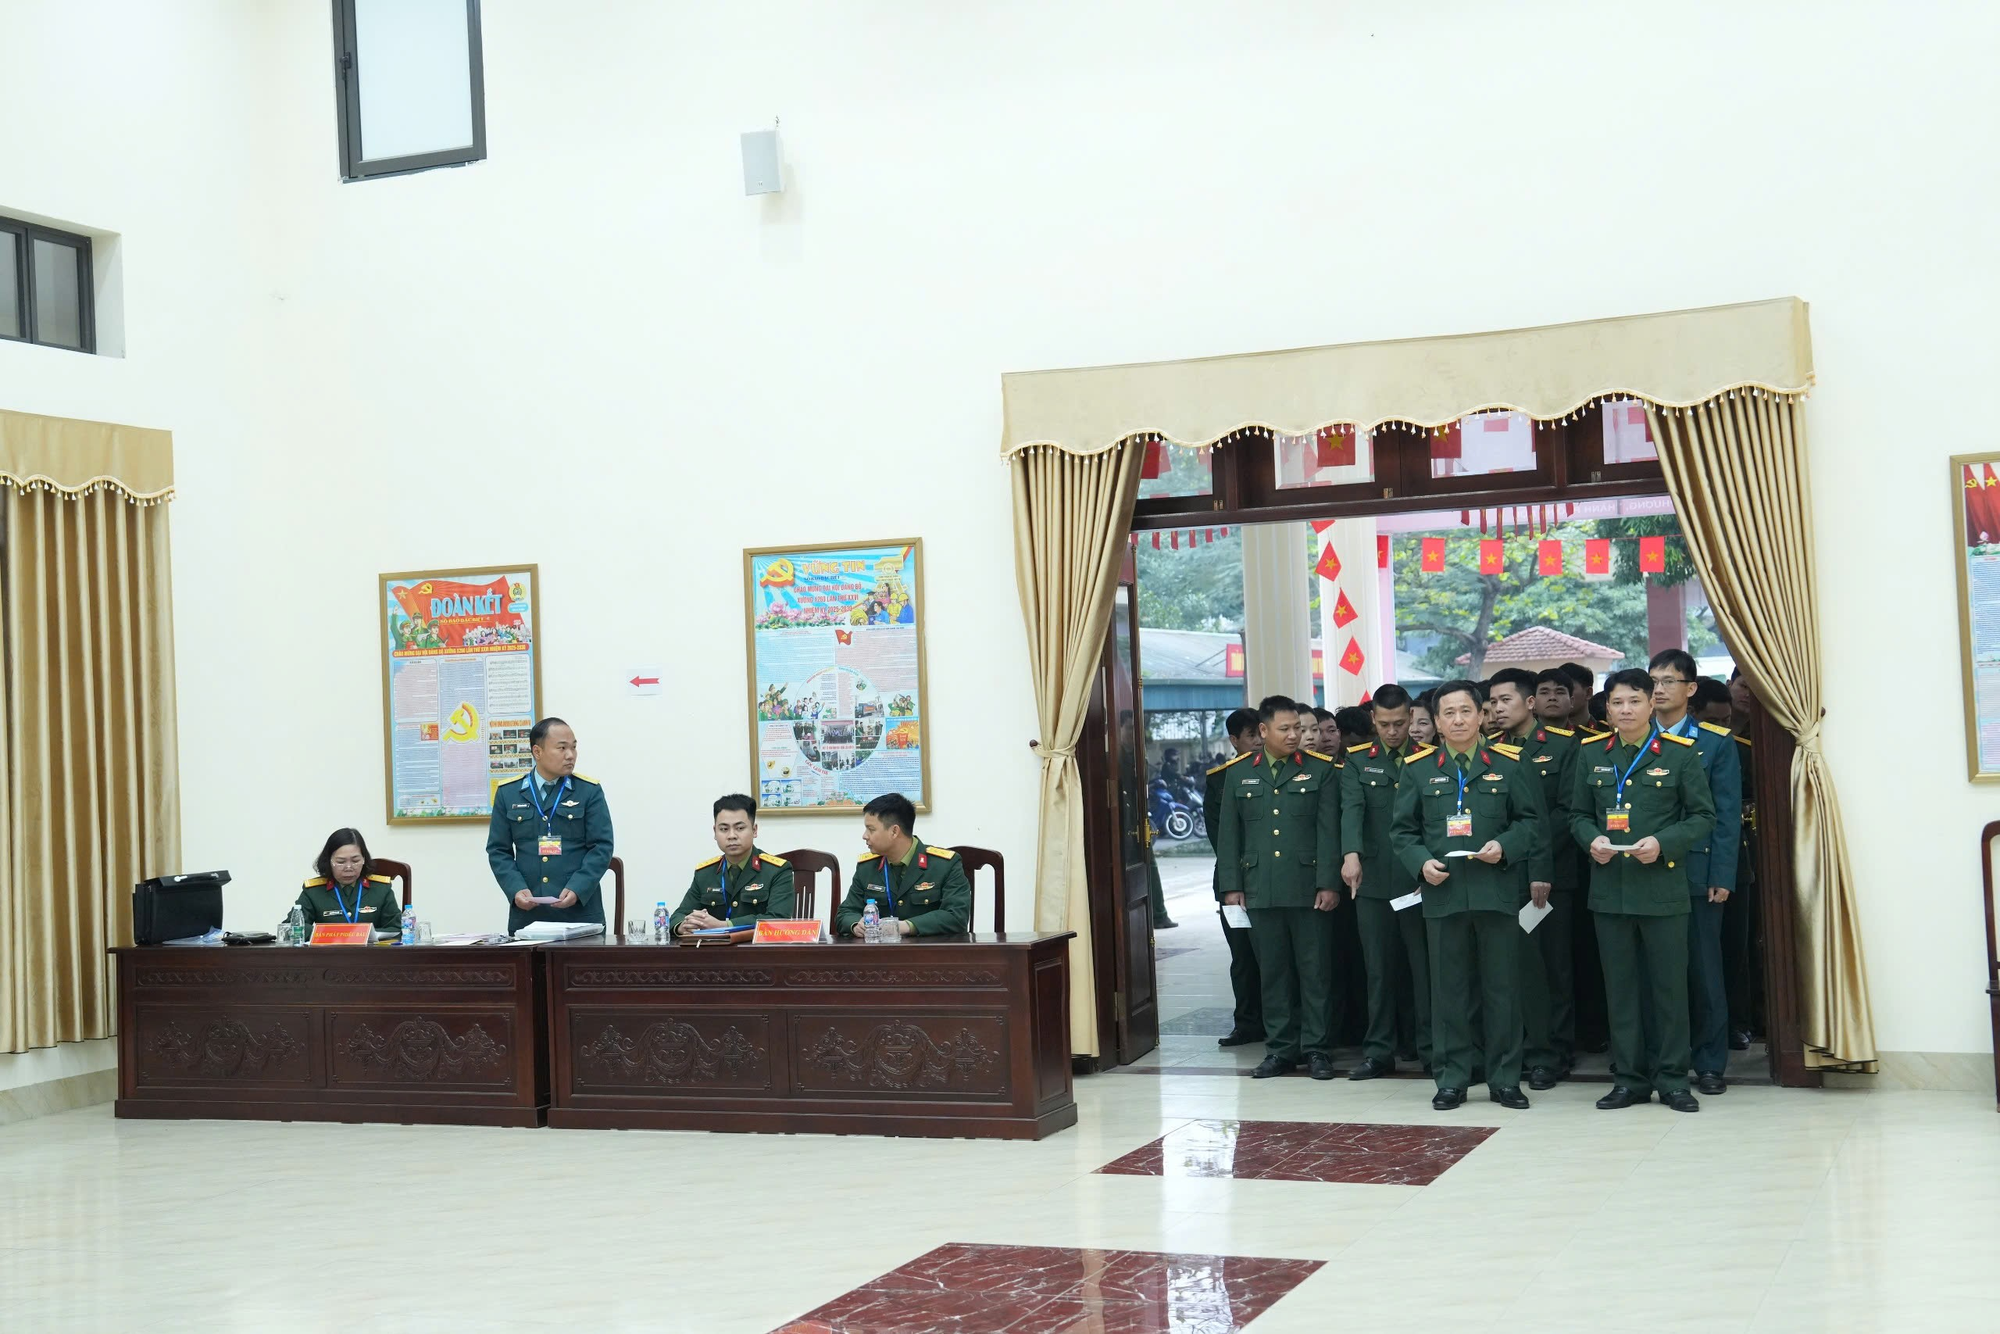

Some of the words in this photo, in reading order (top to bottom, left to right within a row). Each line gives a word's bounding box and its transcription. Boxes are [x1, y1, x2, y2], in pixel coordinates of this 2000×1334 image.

[841, 561, 865, 572] TIN
[430, 593, 473, 618] ĐOÀN
[475, 587, 503, 615] KẾT
